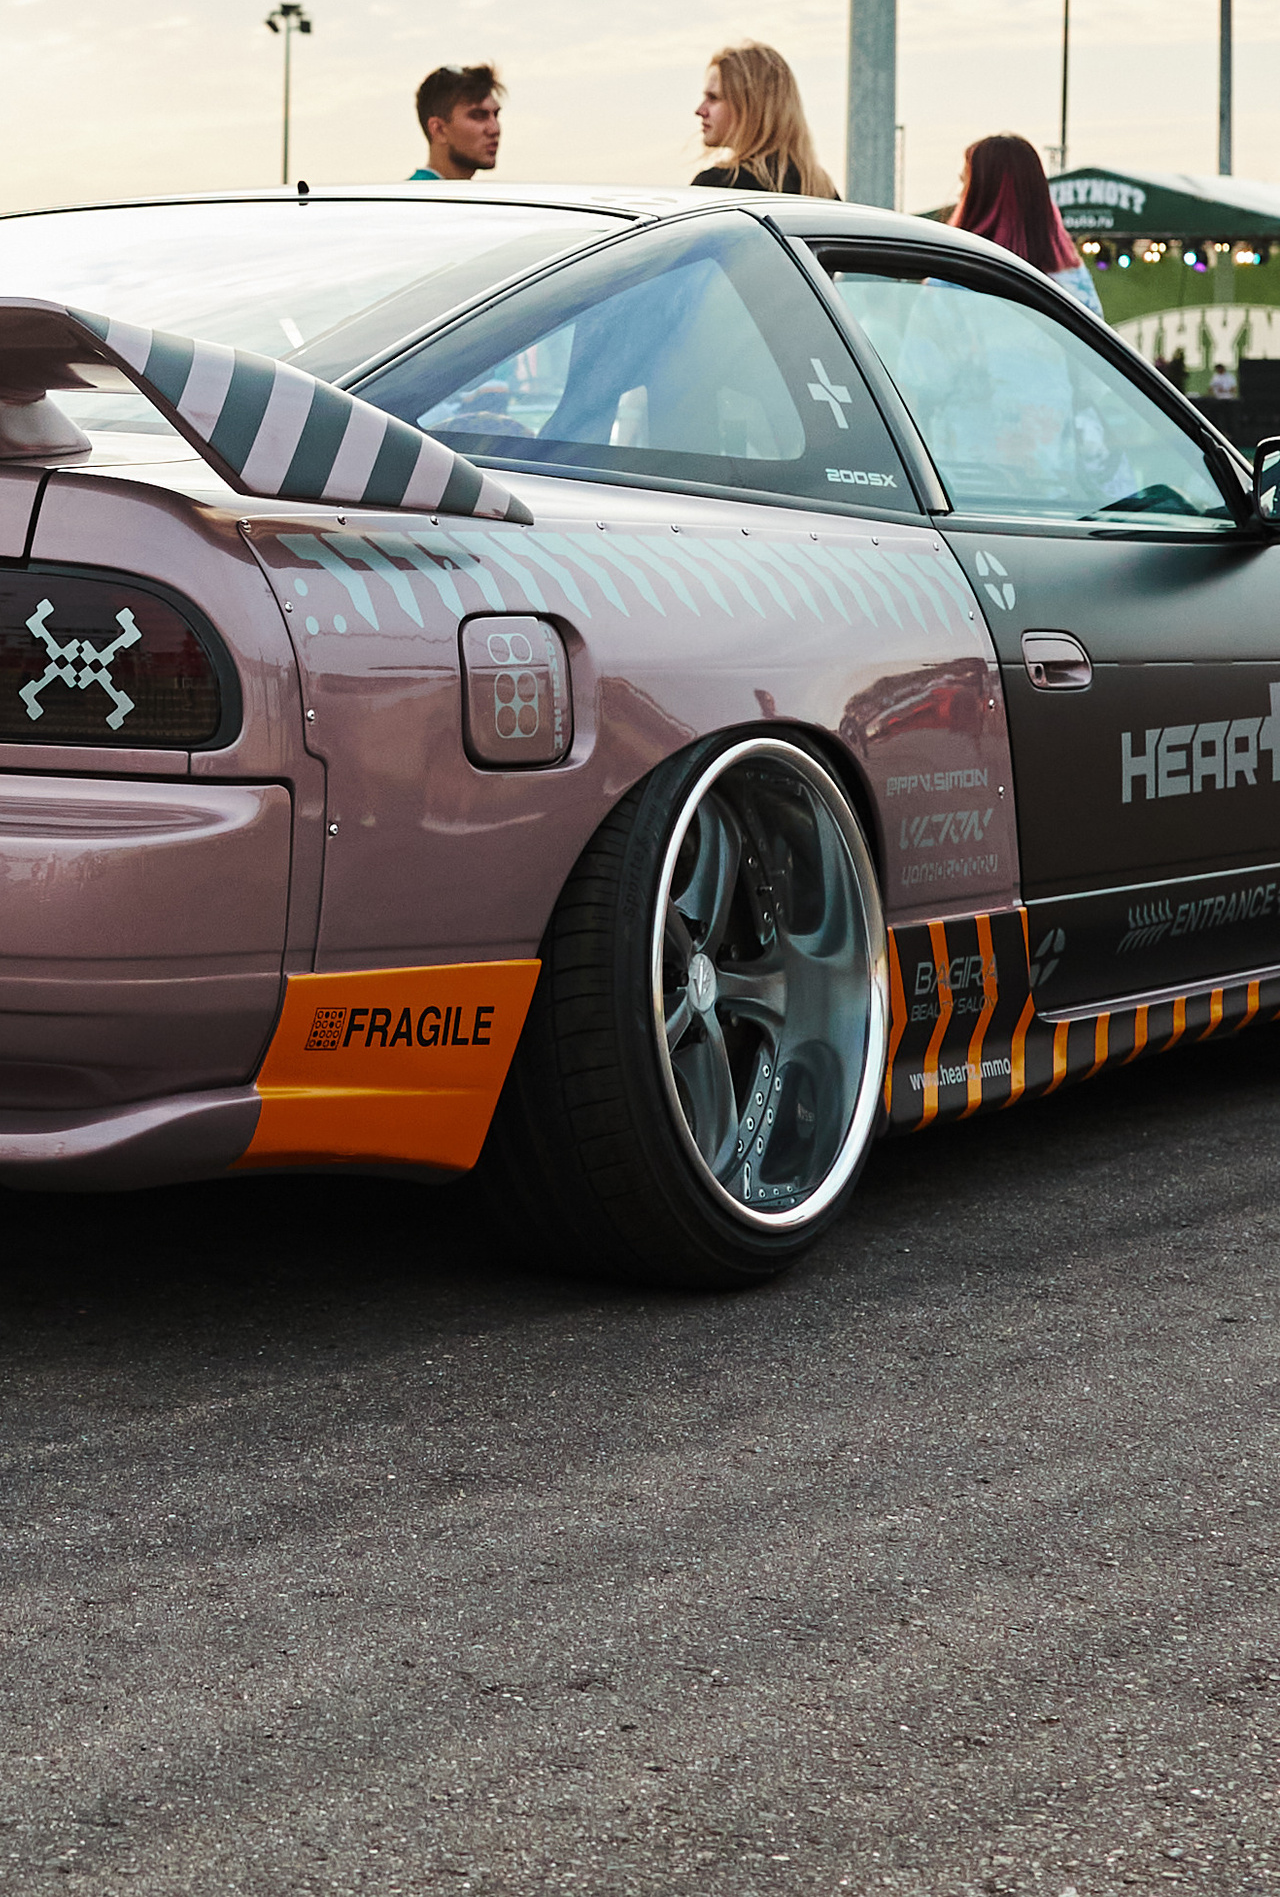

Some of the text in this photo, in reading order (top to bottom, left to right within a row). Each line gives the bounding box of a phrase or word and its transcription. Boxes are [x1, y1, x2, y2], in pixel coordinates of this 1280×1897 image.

[825, 468, 898, 488] 200SX
[1170, 882, 1277, 937] ENTRANCE
[914, 953, 999, 996] BAGIRA
[342, 1005, 495, 1048] FRAGILE
[910, 994, 997, 1022] BEAUTY SALON
